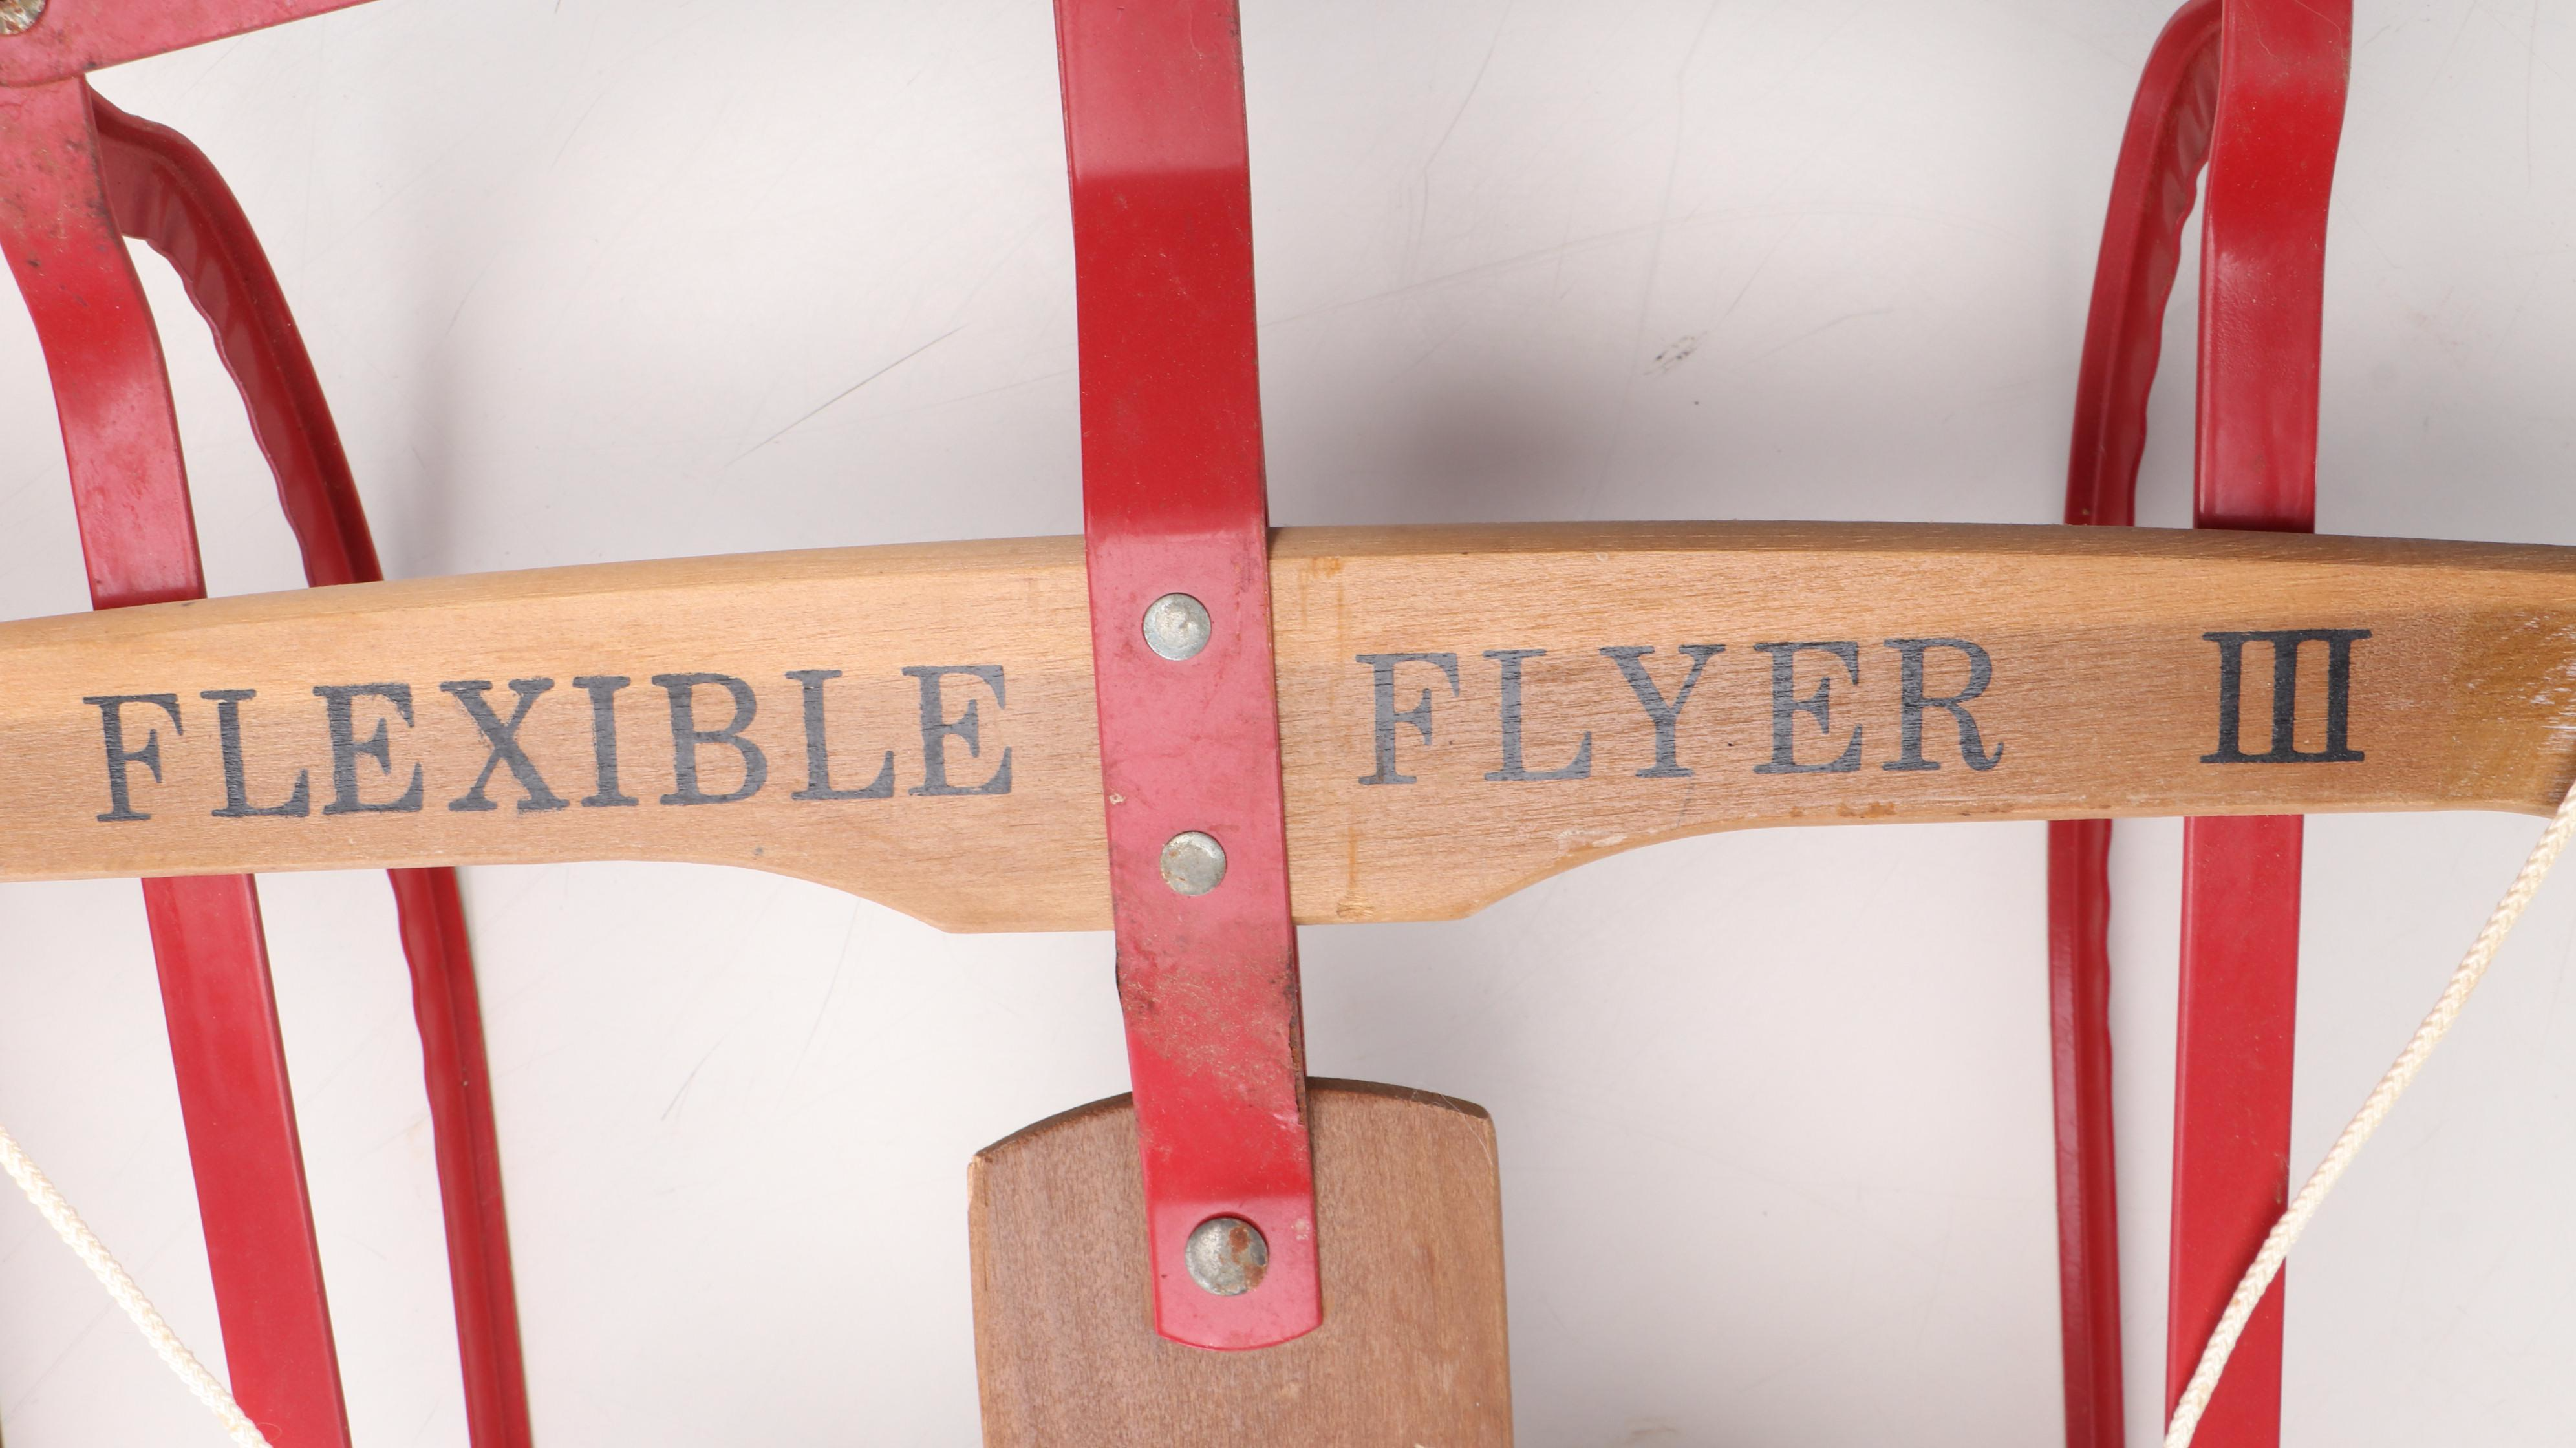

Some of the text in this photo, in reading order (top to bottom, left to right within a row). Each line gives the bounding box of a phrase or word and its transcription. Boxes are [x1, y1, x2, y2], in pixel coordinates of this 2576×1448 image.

[83, 628, 2373, 822] FLEXIBLE FLYER III
